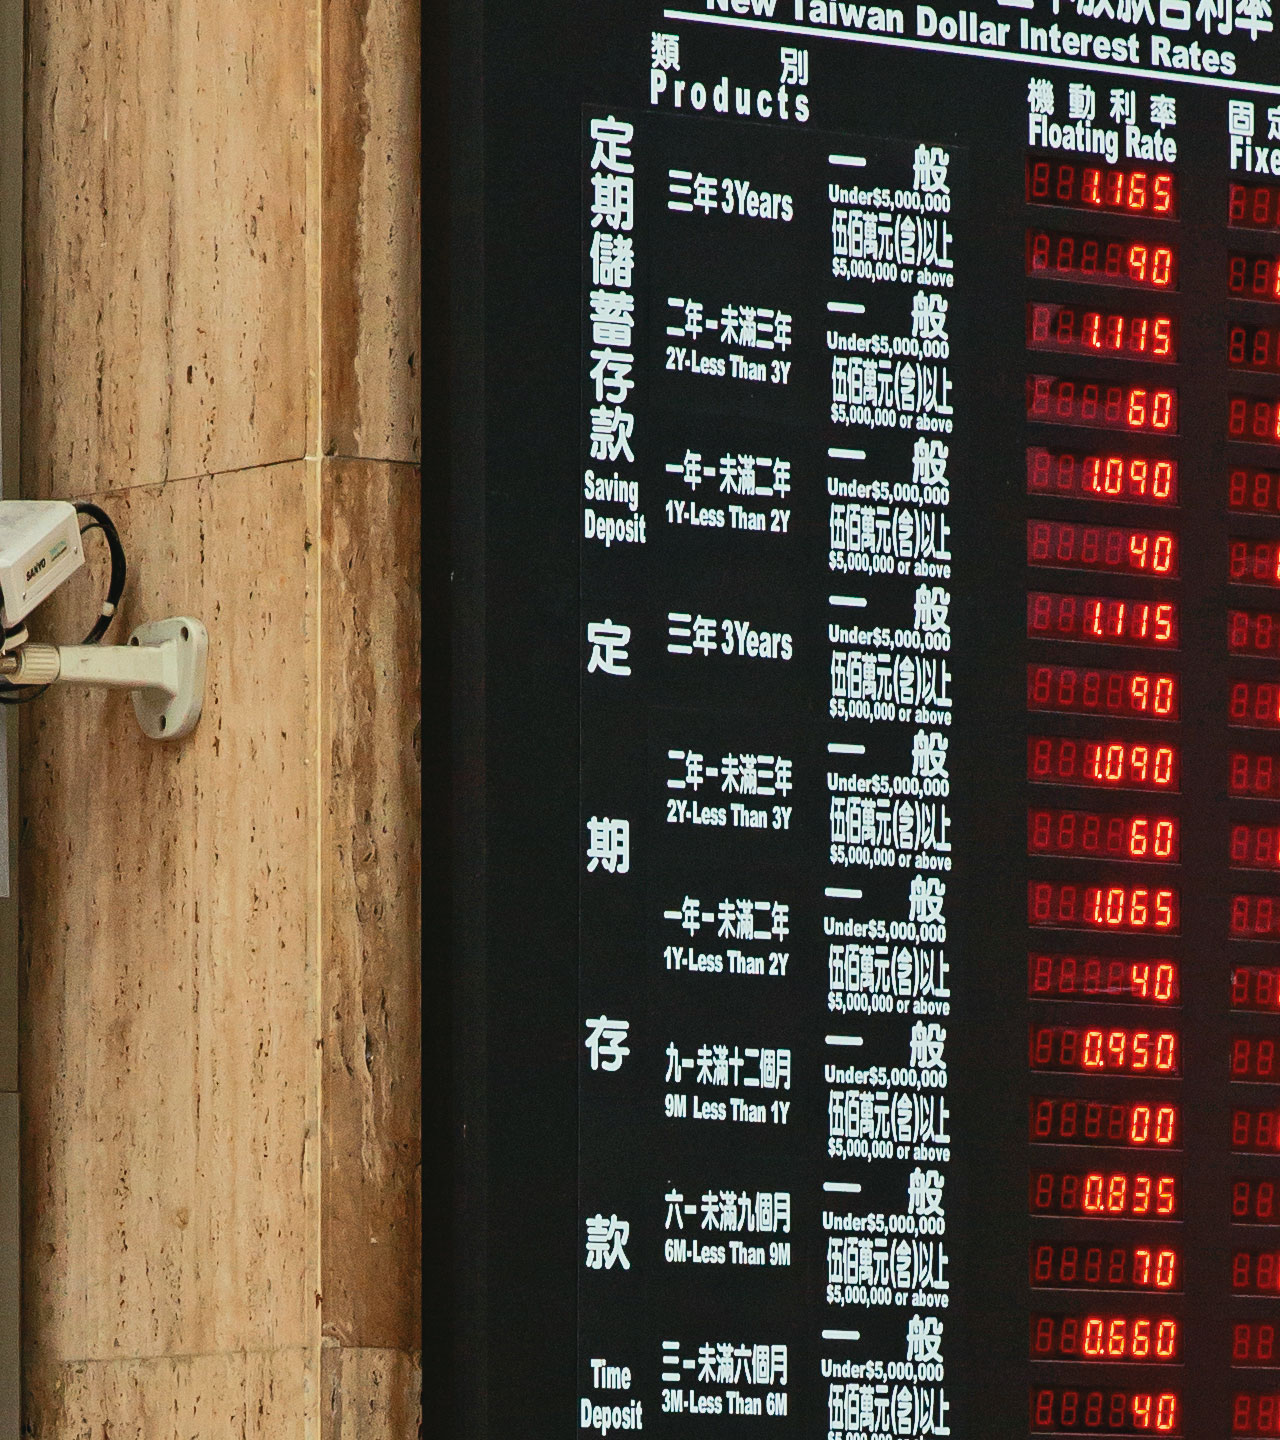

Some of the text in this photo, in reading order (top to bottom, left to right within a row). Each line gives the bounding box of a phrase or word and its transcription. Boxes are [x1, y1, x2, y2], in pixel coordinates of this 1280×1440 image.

[651, 32, 809, 85] 類別
[913, 5, 1010, 53] Dollar
[1017, 16, 1141, 66] Interest
[1149, 35, 1236, 78] Rates
[651, 66, 809, 122] Products
[1027, 77, 1177, 129] 機動利率
[1029, 111, 1177, 164] Floating Rate
[829, 181, 950, 216] Under$5,000,000
[1093, 172, 1170, 210] 1.165
[831, 208, 953, 267] 伍佰萬元(含)以上
[832, 254, 953, 287] $5,000,000 or above
[1130, 247, 1170, 284] 90
[589, 114, 635, 462] 定期儲蓄存款
[1093, 316, 1169, 355] 1.115
[666, 346, 791, 384] 2Y-Less Than 3Y
[584, 470, 638, 514] Saving
[1093, 459, 1171, 497] 1.090
[585, 505, 646, 547] Deposit
[26, 558, 46, 581] SANYO
[1084, 1032, 1174, 1068] 0.950
[1085, 1176, 1173, 1212] 0.835
[1085, 1320, 1175, 1355] 0.660
[591, 1359, 631, 1389] Time
[581, 1398, 642, 1436] Deposit
